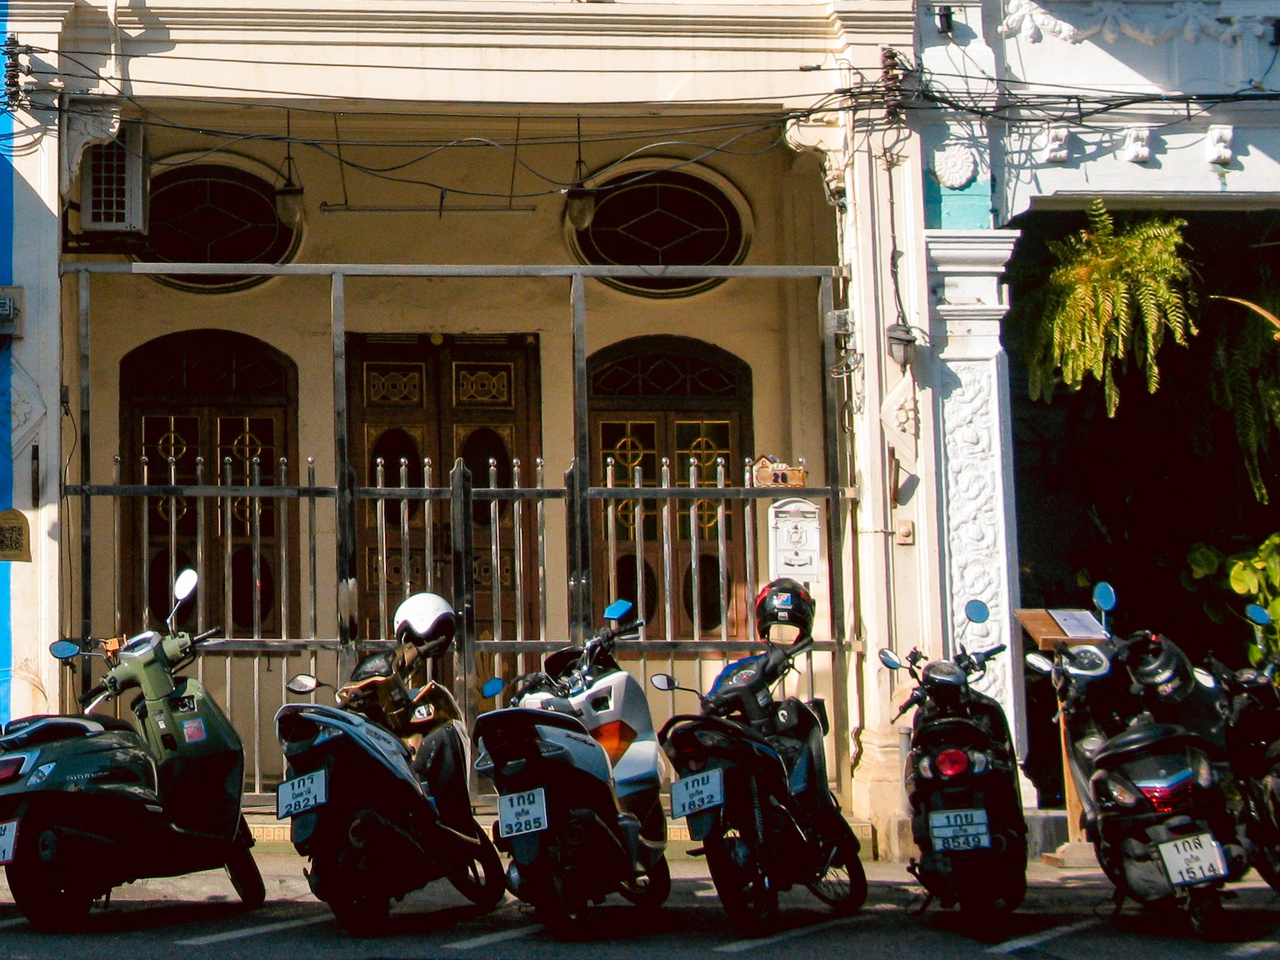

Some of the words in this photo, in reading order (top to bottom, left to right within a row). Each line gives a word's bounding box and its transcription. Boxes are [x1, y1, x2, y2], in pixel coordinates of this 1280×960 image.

[283, 794, 318, 816] 2821
[681, 794, 714, 812] 1832
[505, 817, 542, 835] 3285
[942, 835, 981, 849] 8549
[1178, 862, 1218, 882] 1514
